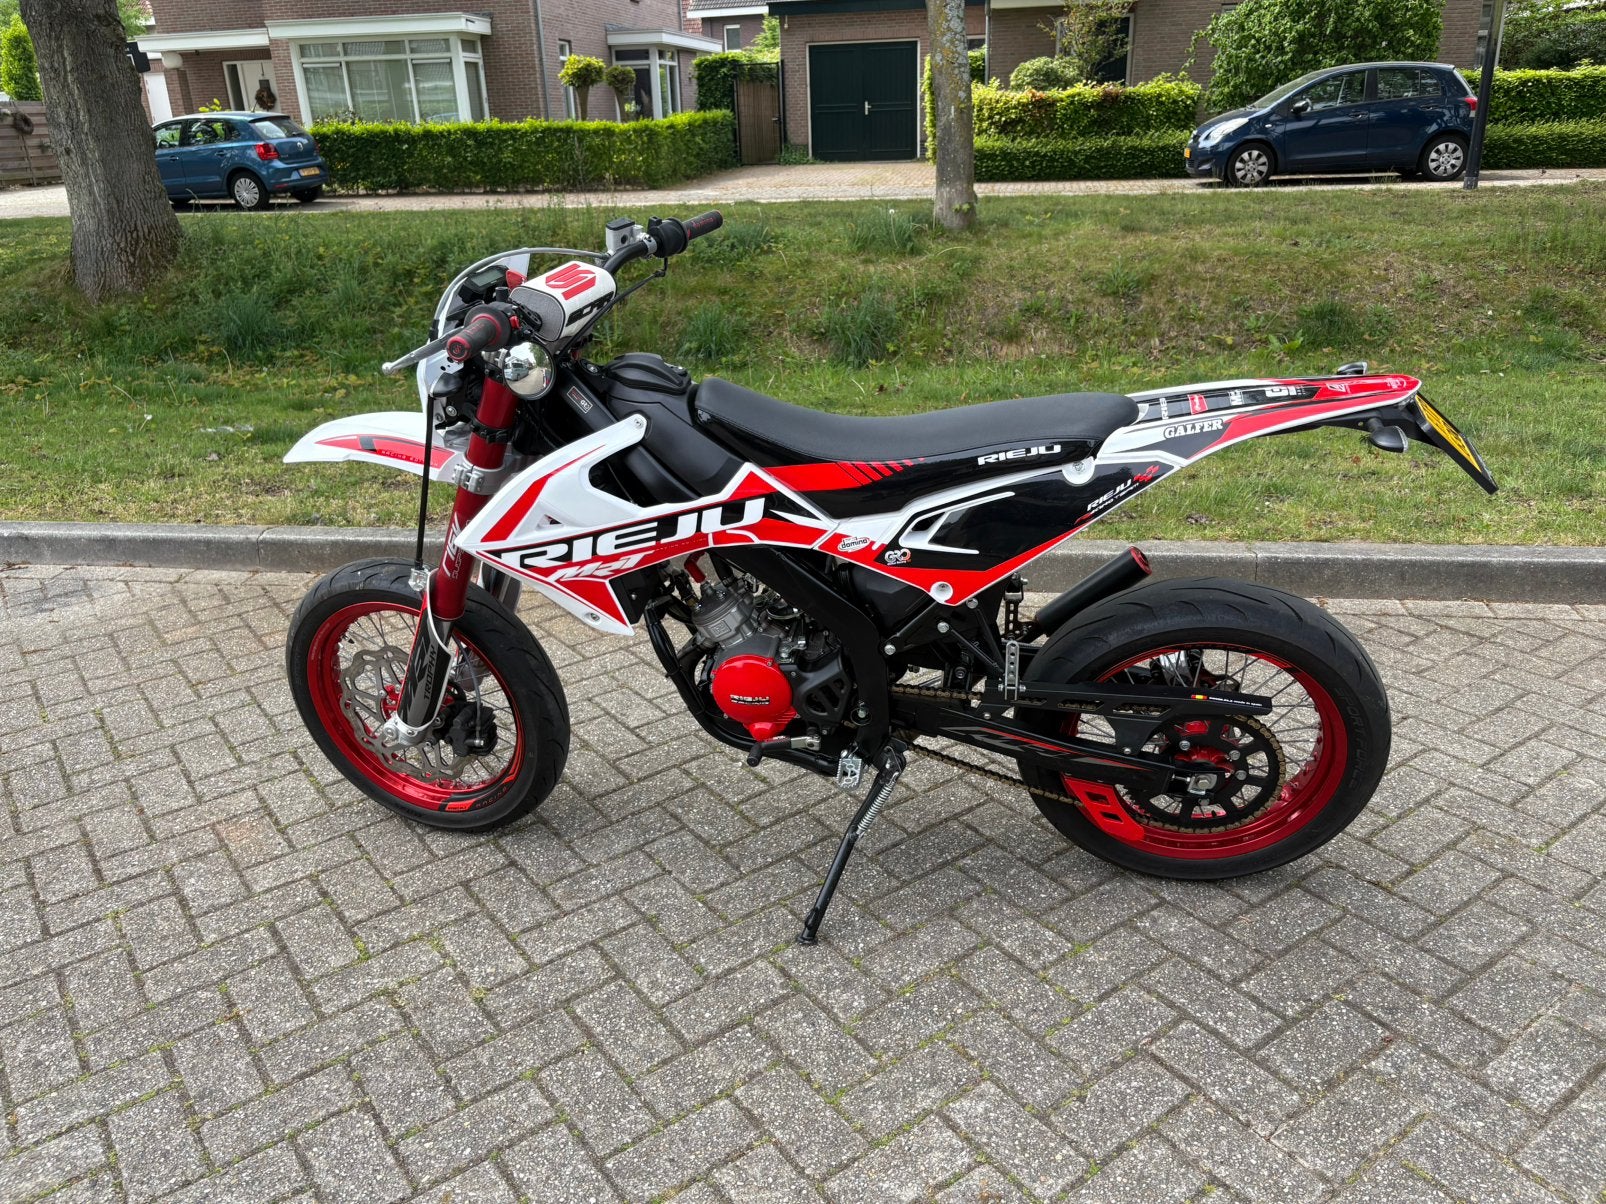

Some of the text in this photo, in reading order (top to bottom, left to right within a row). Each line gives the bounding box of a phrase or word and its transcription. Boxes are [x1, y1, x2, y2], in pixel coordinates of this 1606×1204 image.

[1164, 418, 1224, 439] GALFER
[977, 444, 1062, 466] RIEJU
[1086, 478, 1132, 511] RIEJU
[501, 498, 765, 568] RIEJU
[841, 537, 868, 548] domino
[424, 644, 437, 700] TROPHY
